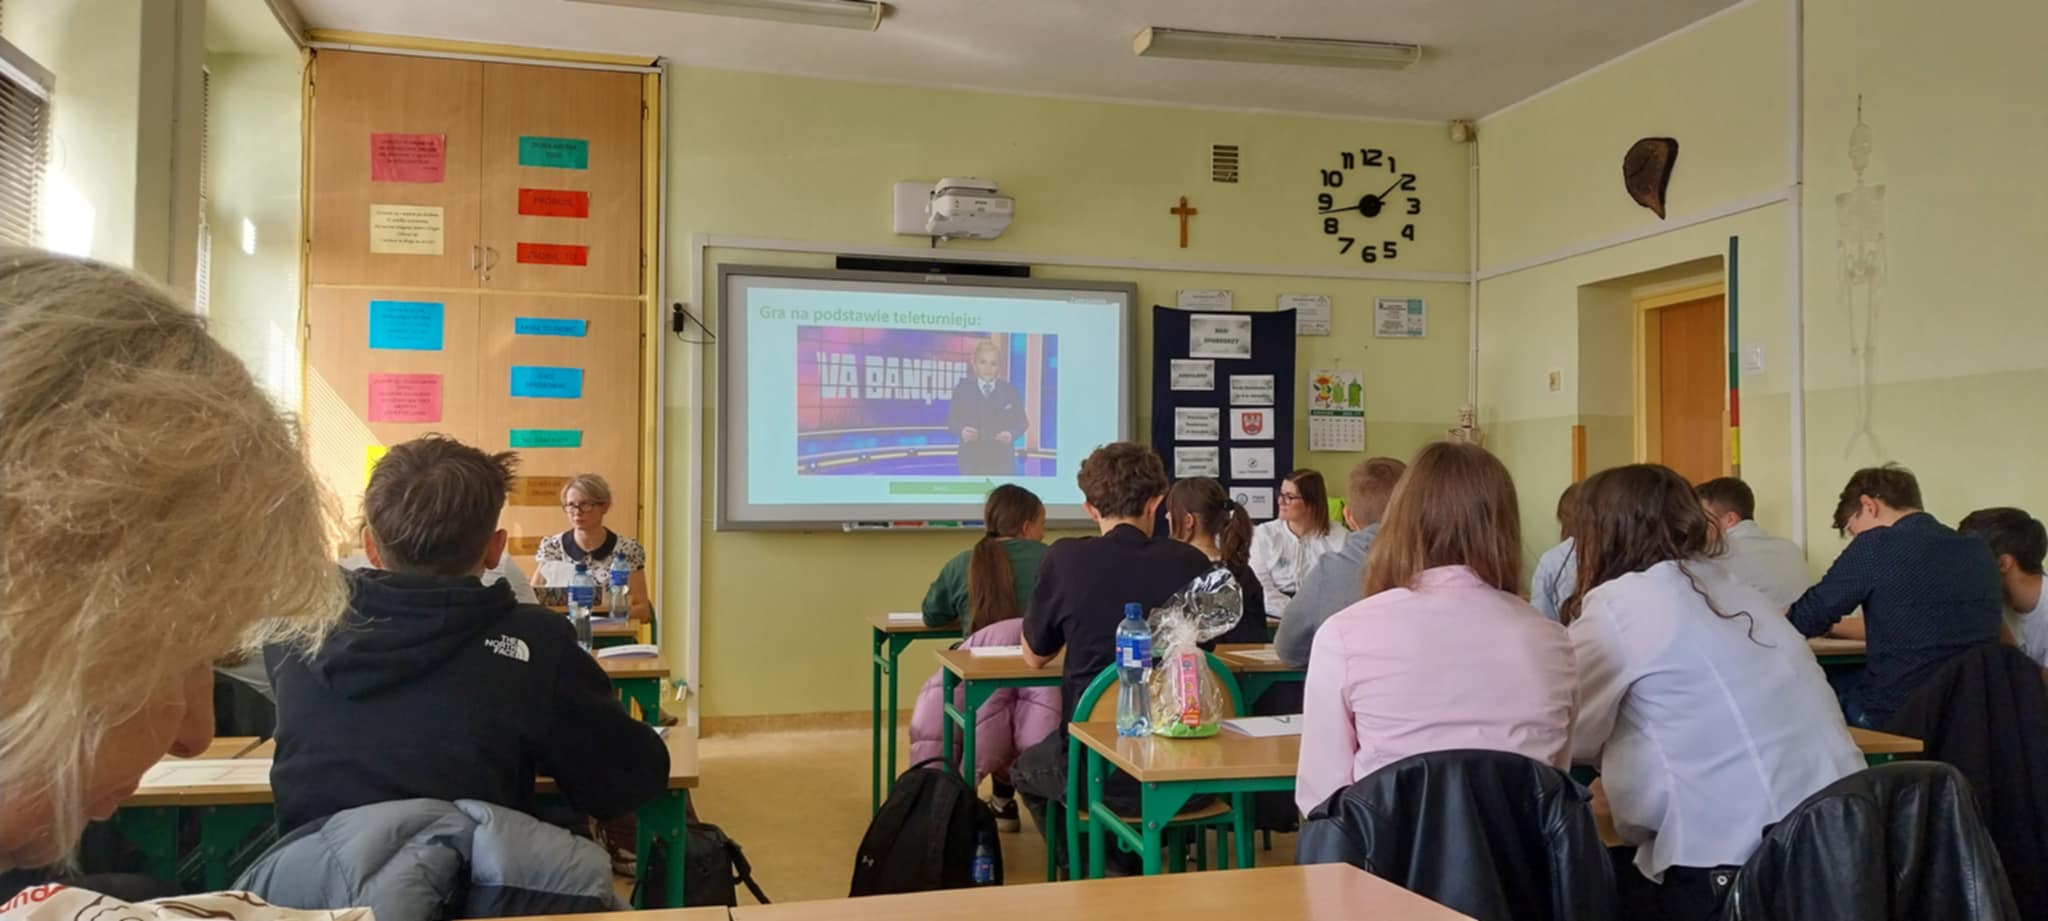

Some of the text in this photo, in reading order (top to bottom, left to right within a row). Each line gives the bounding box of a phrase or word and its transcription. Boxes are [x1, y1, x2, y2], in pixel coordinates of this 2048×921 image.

[1341, 152, 1354, 169] 11
[1360, 148, 1383, 167] 12
[1387, 156, 1395, 173] 1
[1320, 169, 1343, 188] 10
[1400, 173, 1416, 191] 2
[1318, 193, 1333, 211] 9
[1406, 198, 1421, 215] 3
[1324, 217, 1339, 235] 8
[1401, 224, 1414, 241] 4
[1338, 237, 1355, 255] 7
[1362, 245, 1377, 263] 6
[1383, 241, 1397, 259] 5
[759, 305, 982, 329] Gra na podstawie teleturnieju:
[816, 351, 859, 400] VA
